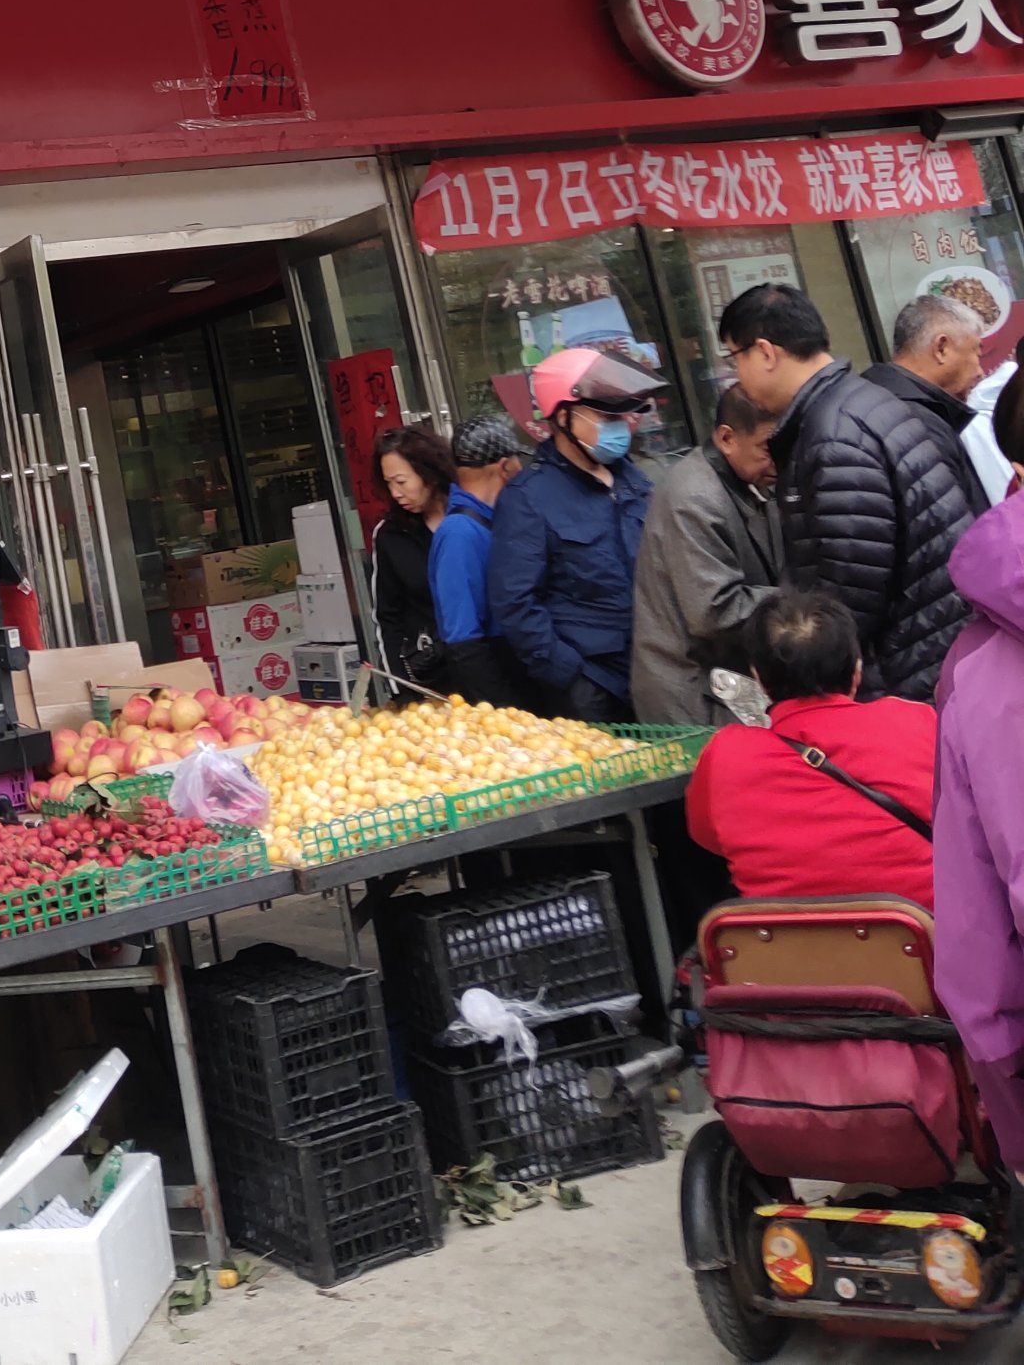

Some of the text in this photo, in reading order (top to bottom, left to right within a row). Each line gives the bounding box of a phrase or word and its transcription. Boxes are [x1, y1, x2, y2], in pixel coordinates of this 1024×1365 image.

[439, 139, 965, 238] 11月7日立冬吃水饺 就来喜家德
[911, 227, 987, 264] 卤肉饭
